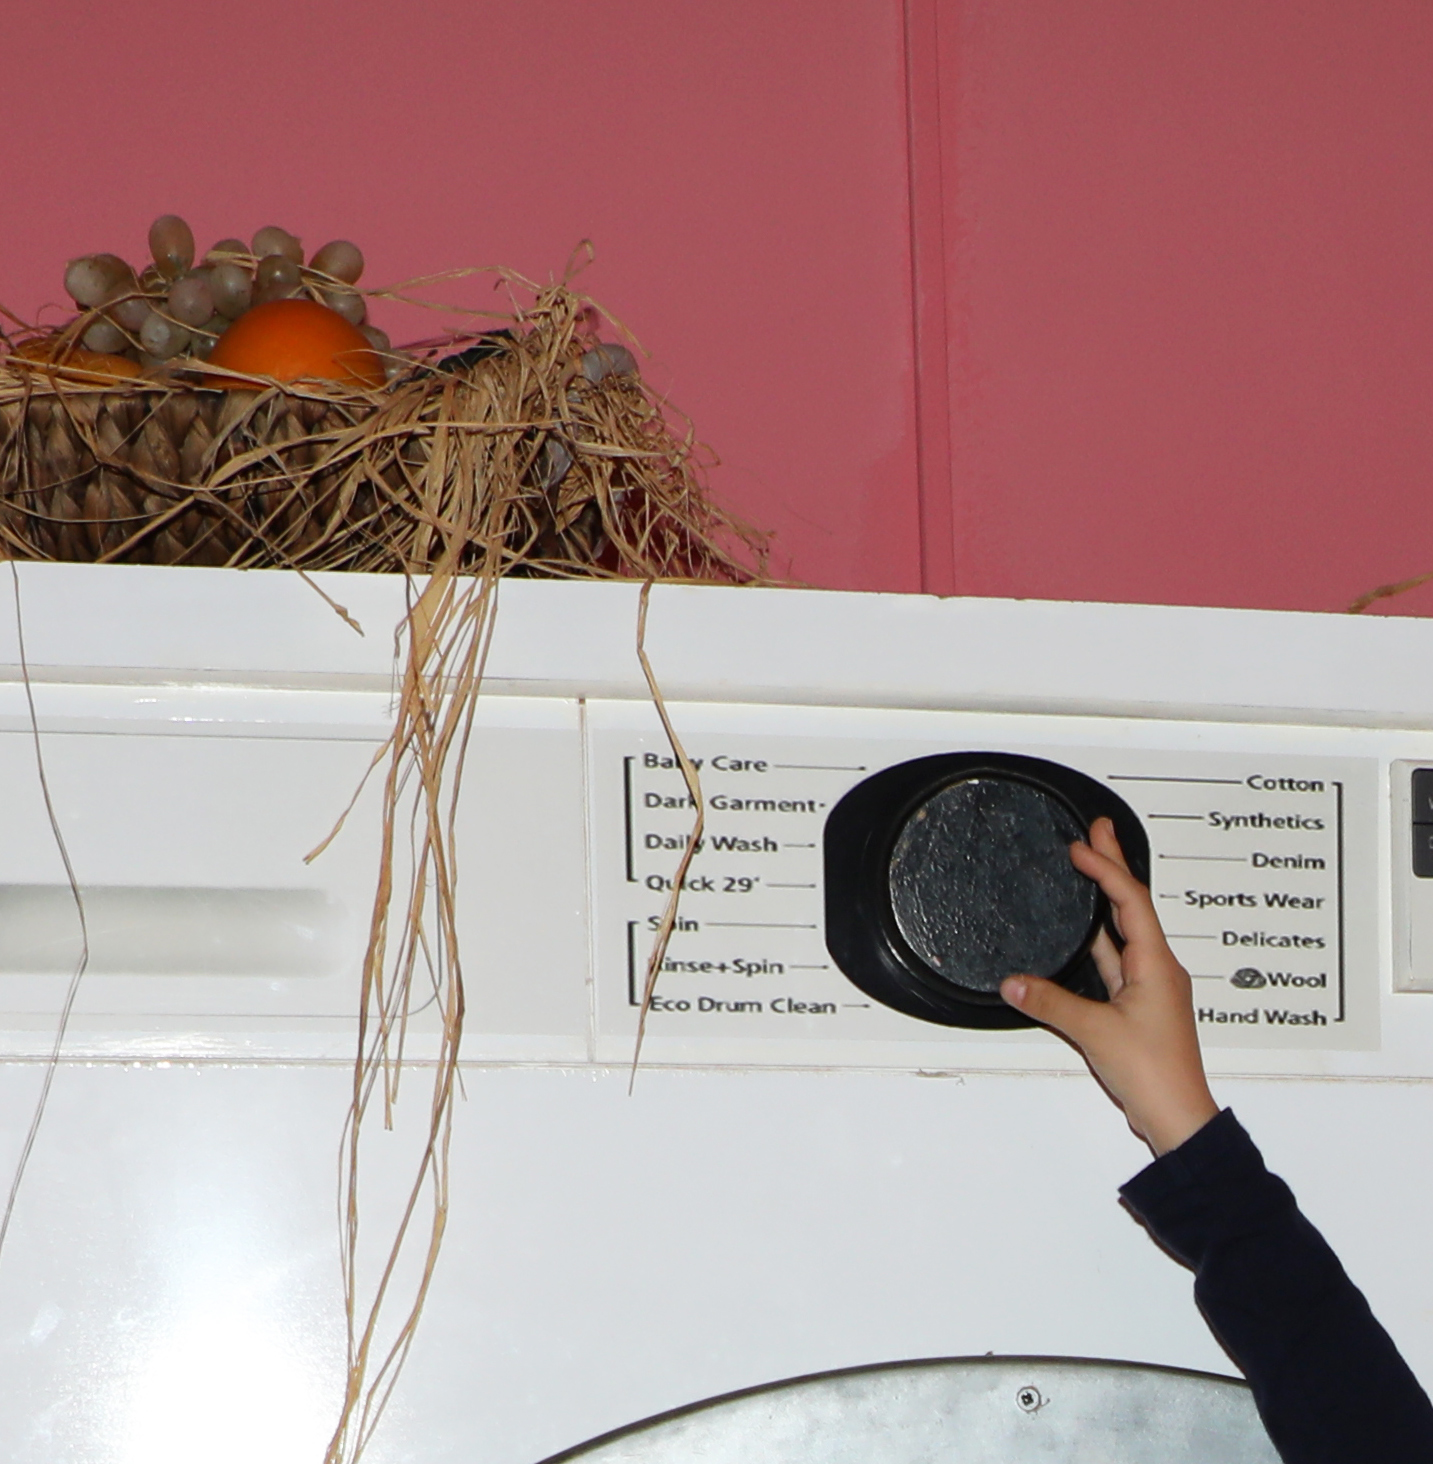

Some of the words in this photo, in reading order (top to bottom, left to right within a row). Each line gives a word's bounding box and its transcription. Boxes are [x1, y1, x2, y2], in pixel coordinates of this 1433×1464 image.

[711, 756, 768, 772] Care
[1246, 774, 1325, 792] Cotton
[710, 795, 816, 813] Garment
[1208, 811, 1325, 831] Synthetics
[711, 836, 778, 852] Wash
[1252, 852, 1326, 870] Denim
[1184, 890, 1258, 909] Sports
[1264, 893, 1325, 909] Wear
[647, 915, 699, 932] Sin
[1222, 931, 1326, 949] Delicates
[651, 957, 784, 977] inse+Spin
[1267, 972, 1327, 988] Wool
[650, 995, 691, 1012] Eco
[698, 996, 762, 1013] Drum
[771, 998, 837, 1014] Clean
[1198, 1008, 1258, 1024] Hand
[1264, 1010, 1327, 1026] Wash
